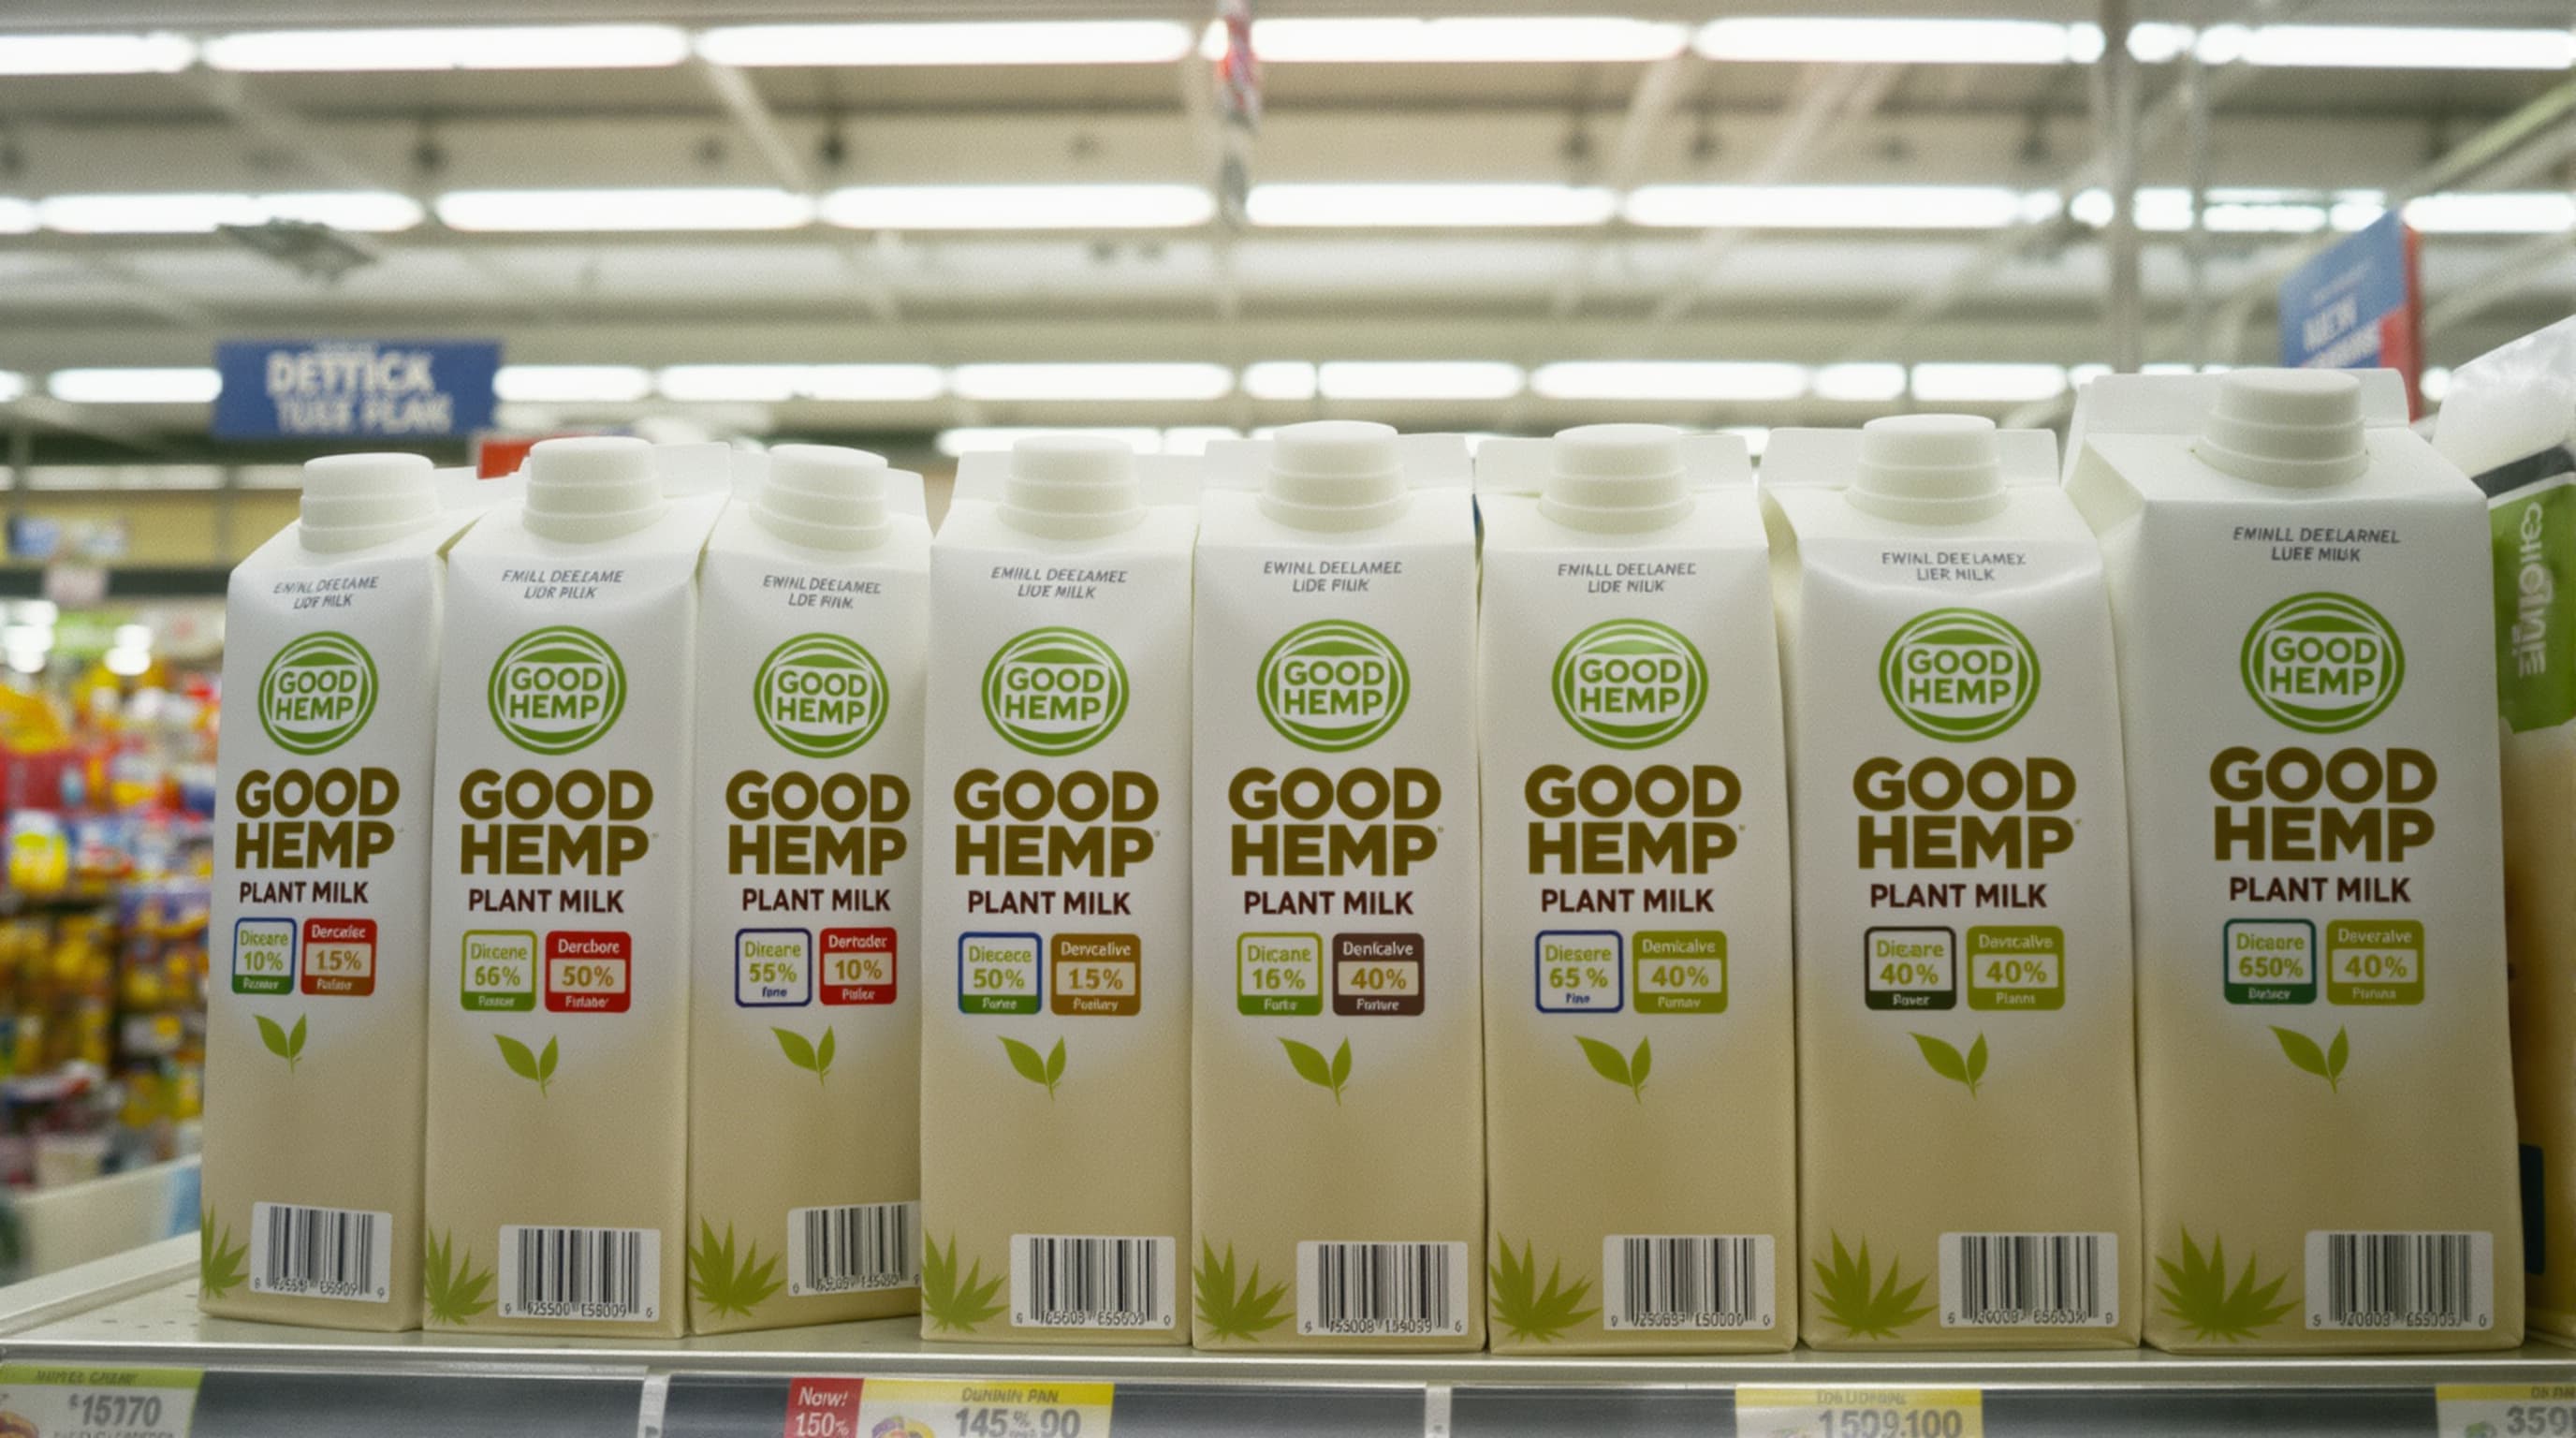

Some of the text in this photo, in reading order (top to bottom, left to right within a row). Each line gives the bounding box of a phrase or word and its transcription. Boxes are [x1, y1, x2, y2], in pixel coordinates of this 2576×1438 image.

[1907, 648, 2014, 676] GOOD
[2270, 637, 2378, 666] GOOD
[278, 669, 358, 695] GOOD
[510, 667, 603, 691] GOOD
[778, 670, 868, 697] GOOD
[1007, 668, 1105, 693] GOOD
[1283, 660, 1385, 687] GOOD
[1579, 658, 1683, 685] GOOD
[2270, 667, 2375, 696] HEMP
[1284, 689, 1383, 716] HEMP
[1579, 687, 1681, 713] HEMP
[1908, 677, 2012, 705] HEMP
[275, 697, 354, 721] HEMP
[509, 694, 600, 719] HEMP
[777, 697, 865, 725] HEMP
[1005, 695, 1102, 721] HEMP
[1852, 756, 2076, 813] GOOD
[2210, 746, 2437, 803] GOOD
[236, 767, 400, 818] GOOD
[460, 769, 653, 820] GOOD
[725, 770, 911, 823] GOOD
[954, 768, 1159, 823] GOOD
[1228, 767, 1442, 821] GOOD
[1525, 764, 1742, 818] GOOD
[235, 821, 395, 869] HEMP
[1858, 815, 2074, 870] HEMP
[2214, 806, 2436, 862] HEMP
[461, 824, 650, 876] HEMP
[729, 825, 907, 876] HEMP
[955, 825, 1155, 877] HEMP
[1231, 824, 1438, 876] HEMP
[1529, 821, 1738, 875] HEMP
[240, 881, 369, 904] PLANT MILK
[469, 888, 624, 914] PLANT MILK
[742, 888, 891, 913] PLANT MILK
[968, 890, 1131, 916] PLANT MILK
[1244, 890, 1414, 916] PLANT MILK
[1541, 888, 1715, 913] PLANT MILK
[1871, 884, 2048, 908] PLANT MILK
[2230, 876, 2411, 904] PLANT MILK
[243, 950, 284, 971] 10%
[315, 950, 362, 971] 15%
[749, 962, 798, 983] 55%
[835, 959, 883, 981] 10%
[1880, 961, 1939, 986] 40%
[1985, 960, 2047, 984] 40%
[2238, 956, 2305, 979] 650%
[2344, 954, 2408, 978] 40%
[475, 965, 520, 987] 66%
[562, 965, 615, 988] 50%
[973, 967, 1026, 990] 50%
[1068, 967, 1124, 990] 15%
[1252, 967, 1307, 990] 16%
[1350, 967, 1407, 990] 40%
[1650, 965, 1710, 989] 40%
[955, 1409, 1009, 1438] 145
[2506, 1405, 2576, 1437] 359
